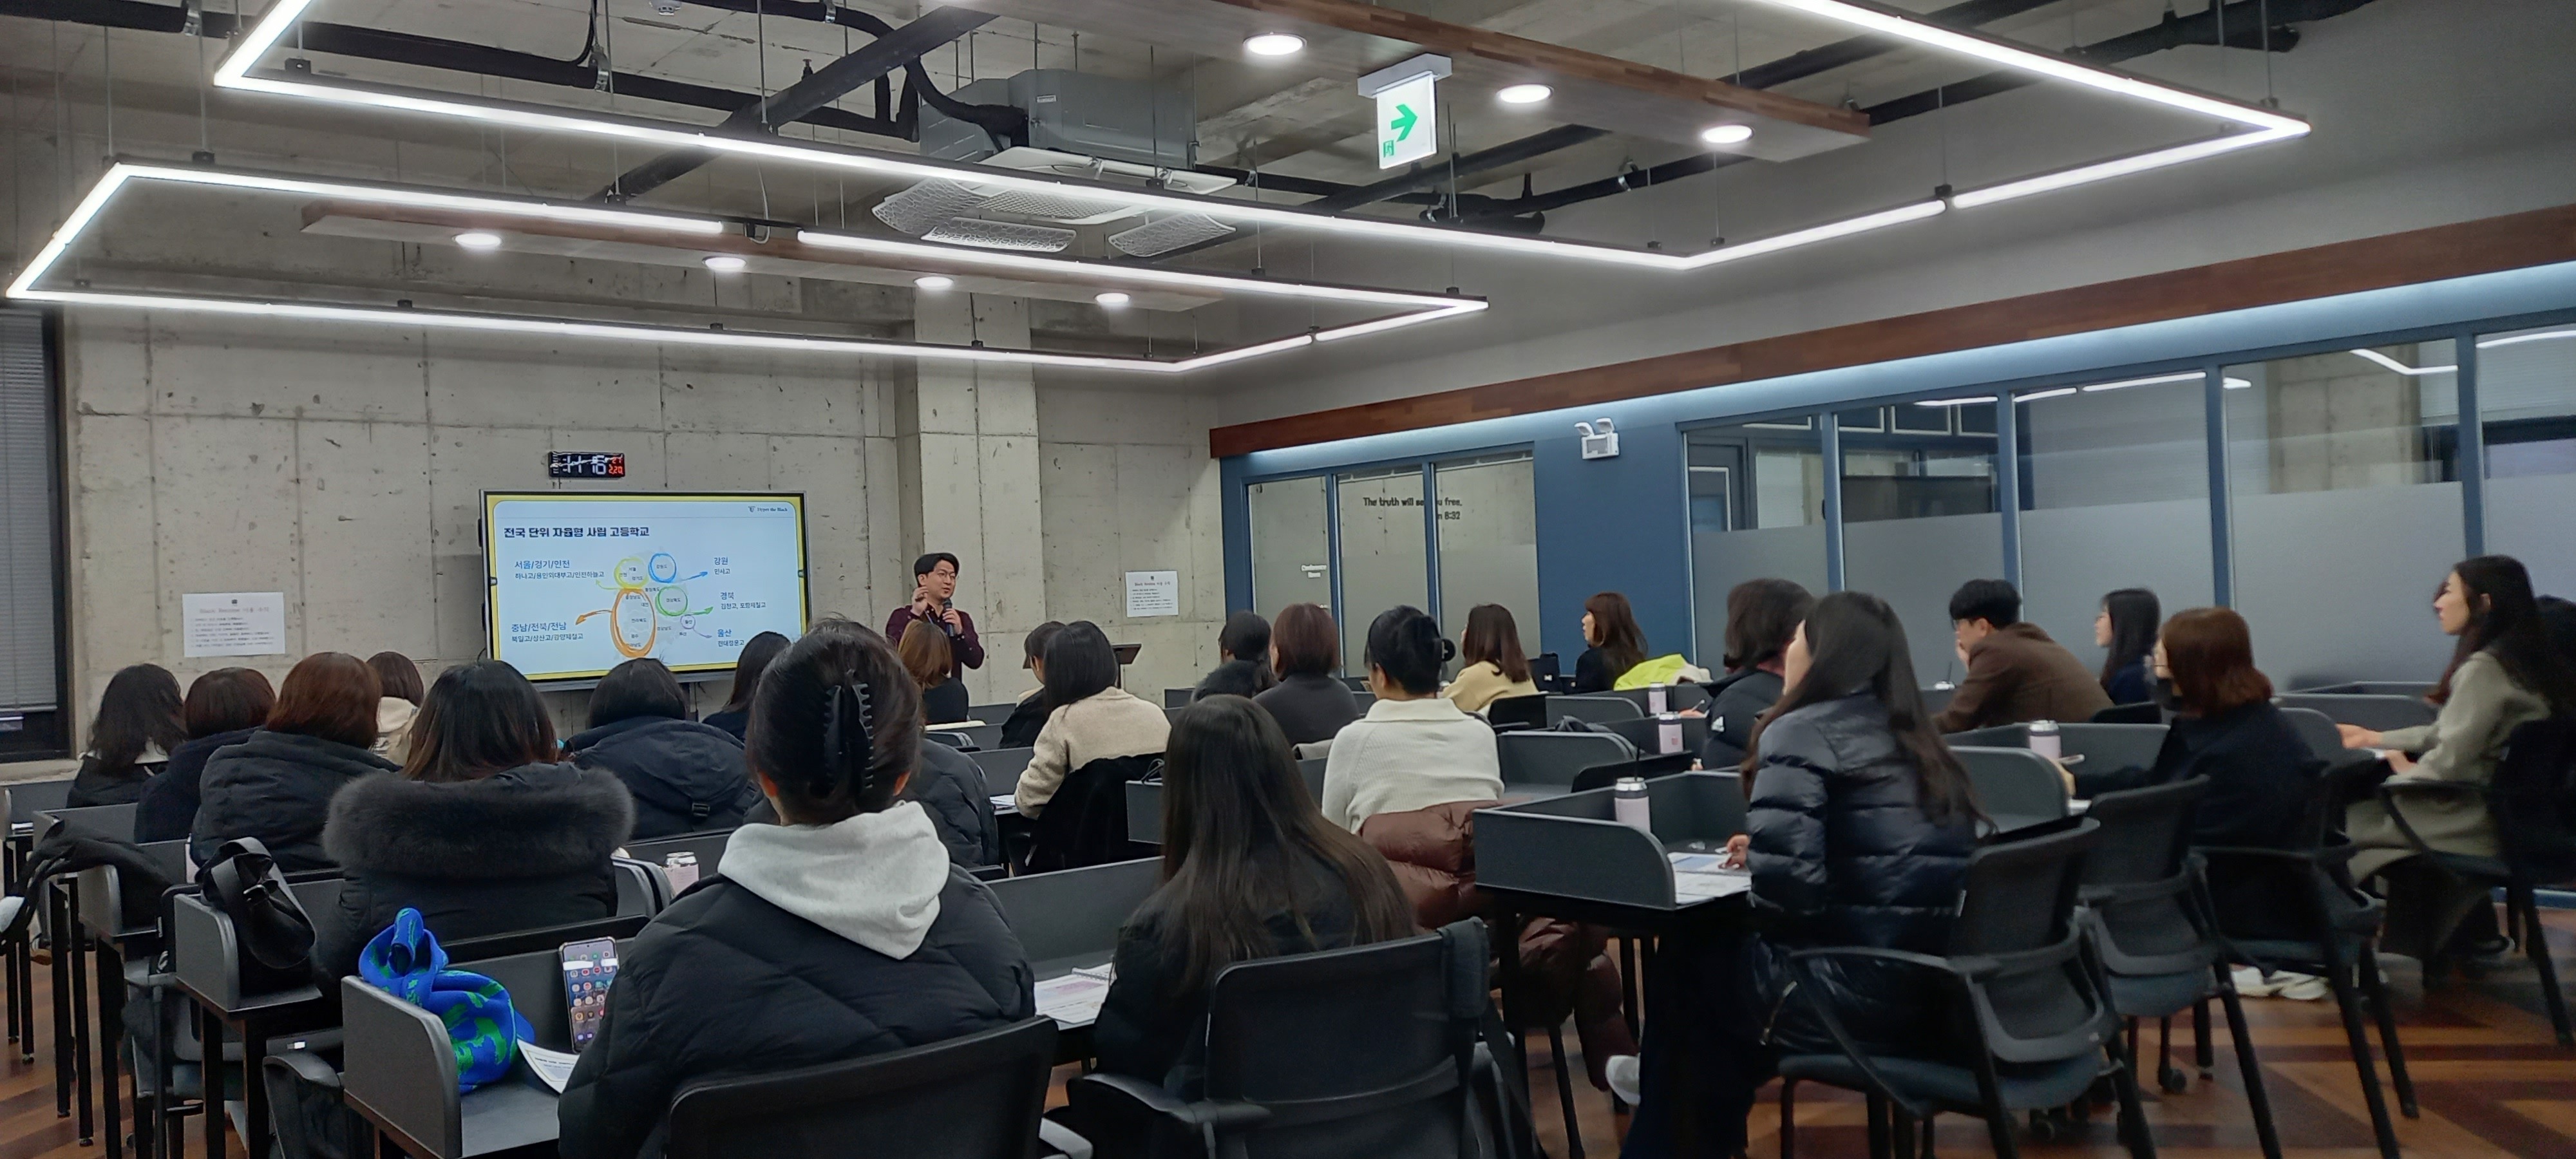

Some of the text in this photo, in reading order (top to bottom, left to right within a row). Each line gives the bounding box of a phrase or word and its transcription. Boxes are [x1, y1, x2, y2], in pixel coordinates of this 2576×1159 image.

[1363, 497, 1377, 506] The
[1379, 496, 1399, 507] truth
[1401, 497, 1414, 506] will
[1444, 497, 1463, 507] free.
[504, 527, 650, 538] 전국 단위 자율형 사립 고등학교
[714, 557, 728, 565] 강원
